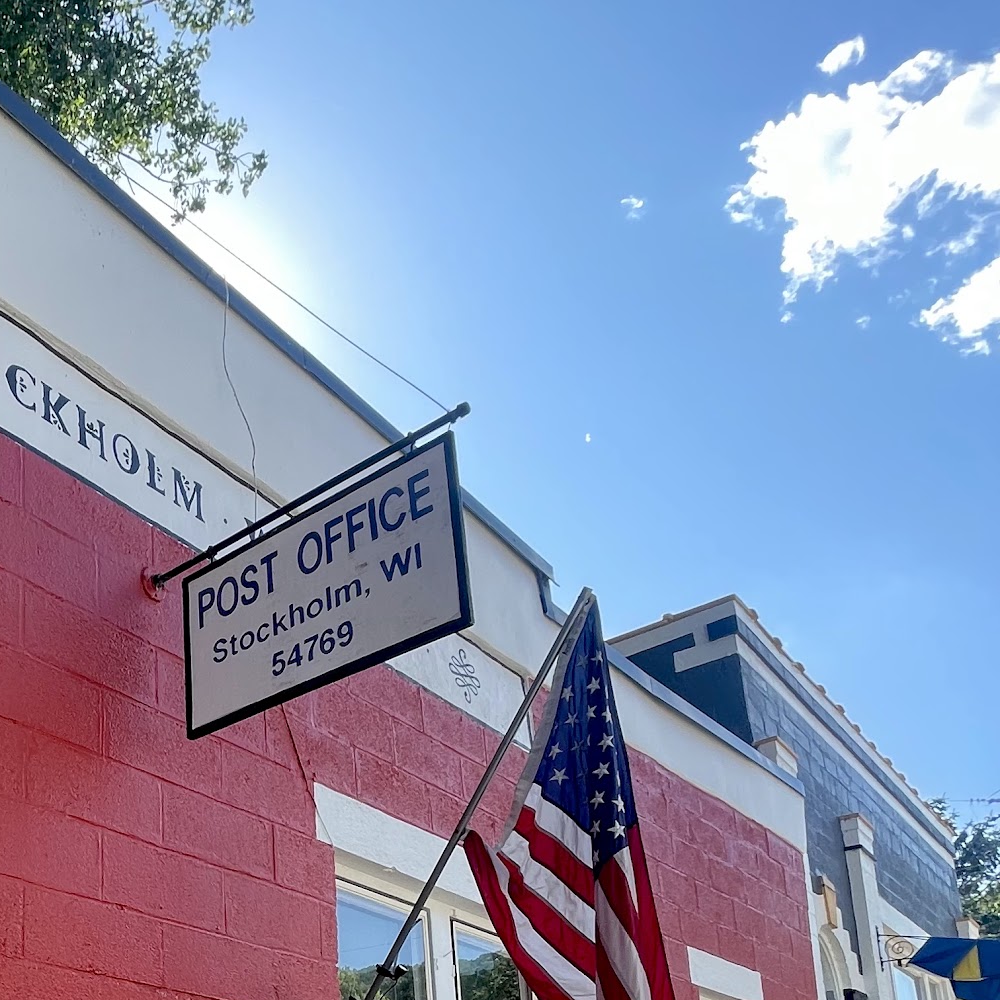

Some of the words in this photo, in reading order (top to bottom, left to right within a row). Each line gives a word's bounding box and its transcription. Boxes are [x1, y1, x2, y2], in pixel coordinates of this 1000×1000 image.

[197, 550, 278, 629] POST
[297, 468, 435, 575] OFFICE
[212, 577, 371, 664] Stockholm,
[380, 542, 423, 583] WI
[271, 620, 355, 677] 54769
